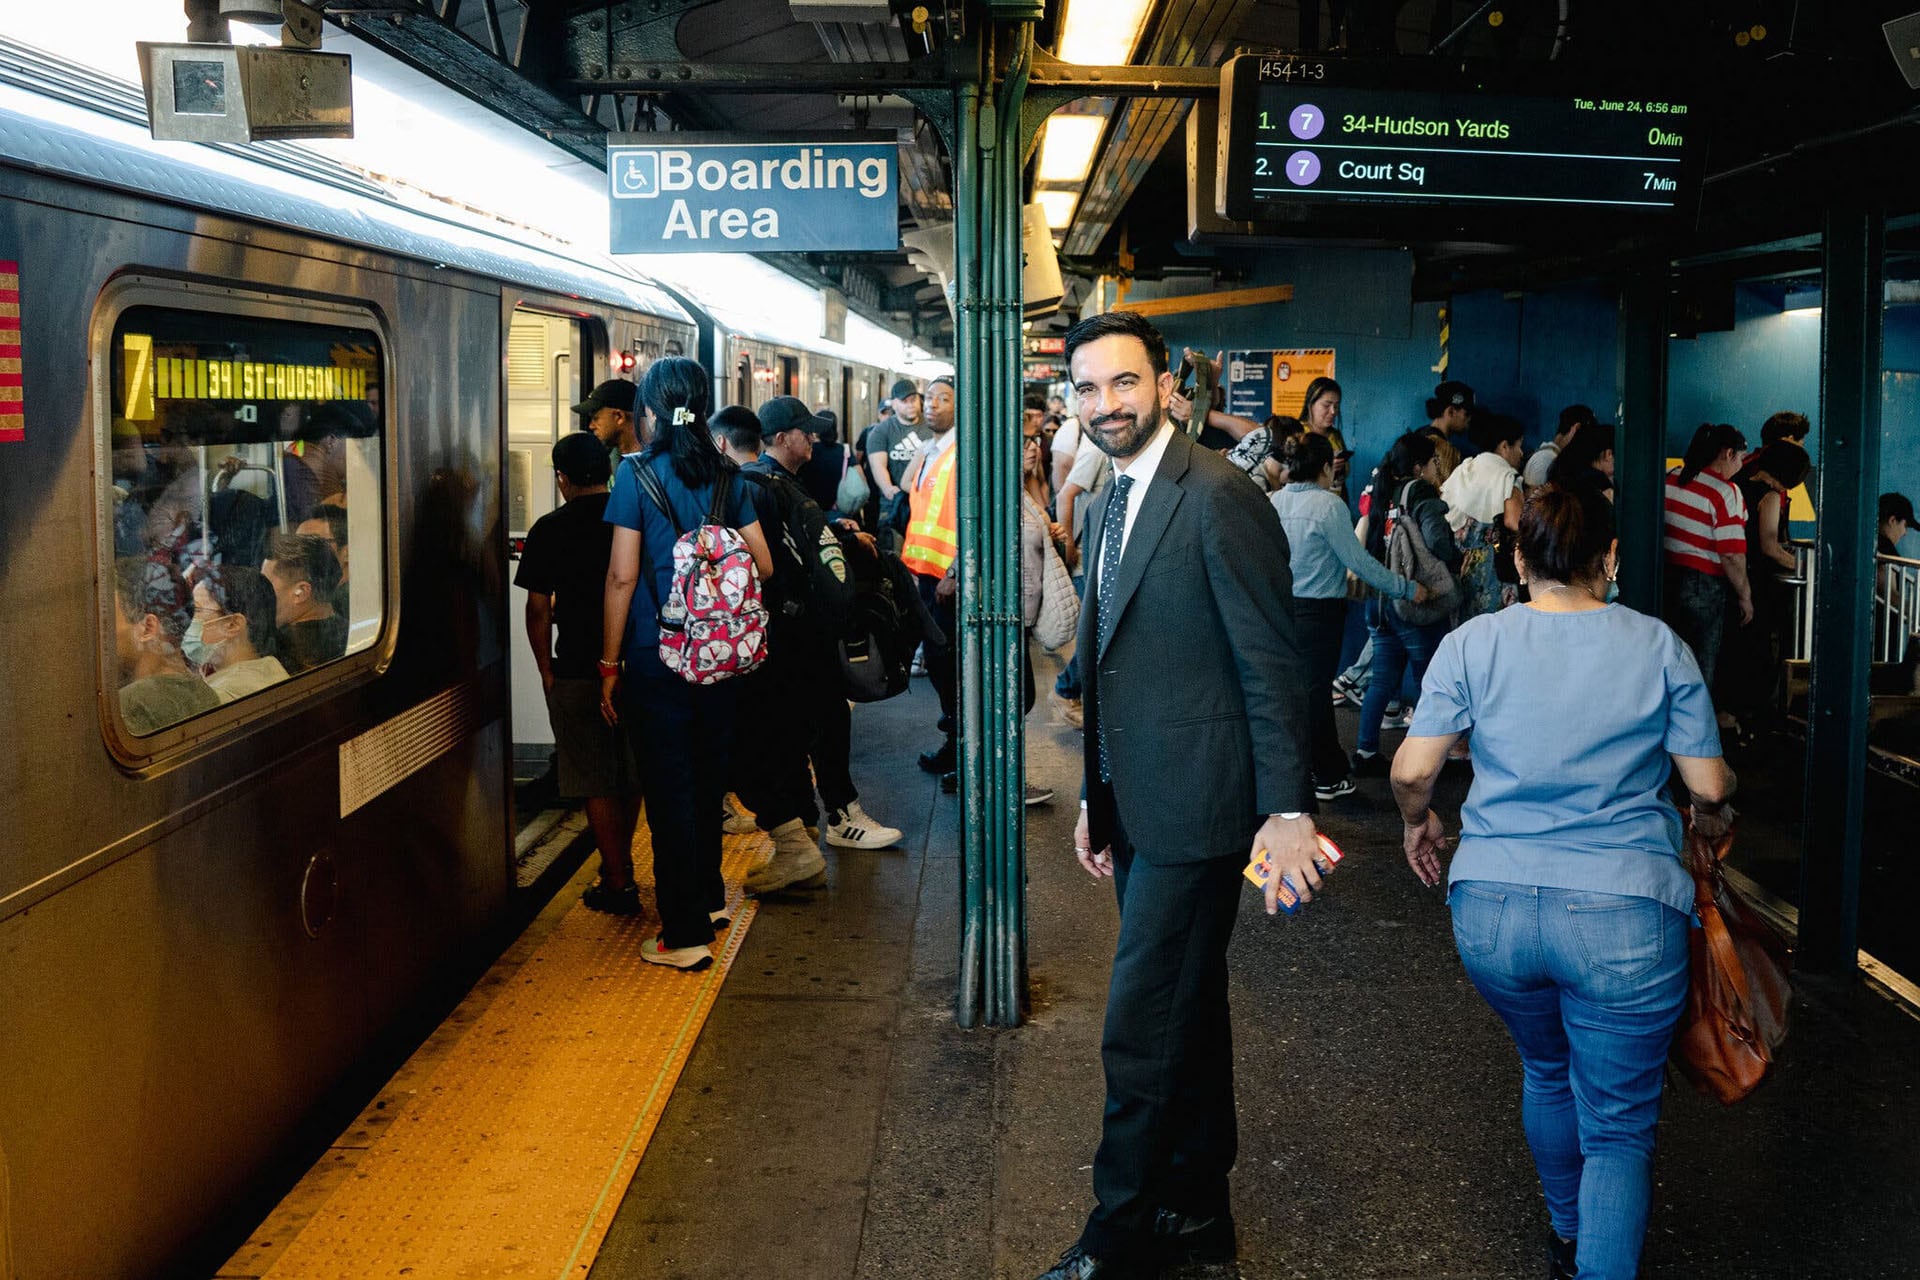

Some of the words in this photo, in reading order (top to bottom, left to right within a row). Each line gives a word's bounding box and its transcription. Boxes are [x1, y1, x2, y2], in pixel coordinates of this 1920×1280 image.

[1261, 61, 1325, 80] 454-1-3
[1574, 98, 1597, 111] Tue,
[1599, 100, 1624, 112] June
[1626, 101, 1643, 113] 24,
[1645, 102, 1669, 114] 6:56
[1670, 104, 1687, 115] am
[1258, 111, 1276, 130] 1.
[1301, 112, 1313, 131] 7
[1342, 114, 1449, 137] 34-Hudson
[1455, 118, 1510, 139] Yards
[660, 148, 887, 198] Boarding
[1255, 157, 1273, 176] 2.
[1297, 159, 1310, 177] 7
[1338, 160, 1393, 180] Court
[1398, 162, 1425, 186] Sq
[662, 199, 780, 240] Area
[124, 333, 153, 420] 7
[209, 361, 232, 398] 34
[243, 362, 334, 399] ST-HUDSON
